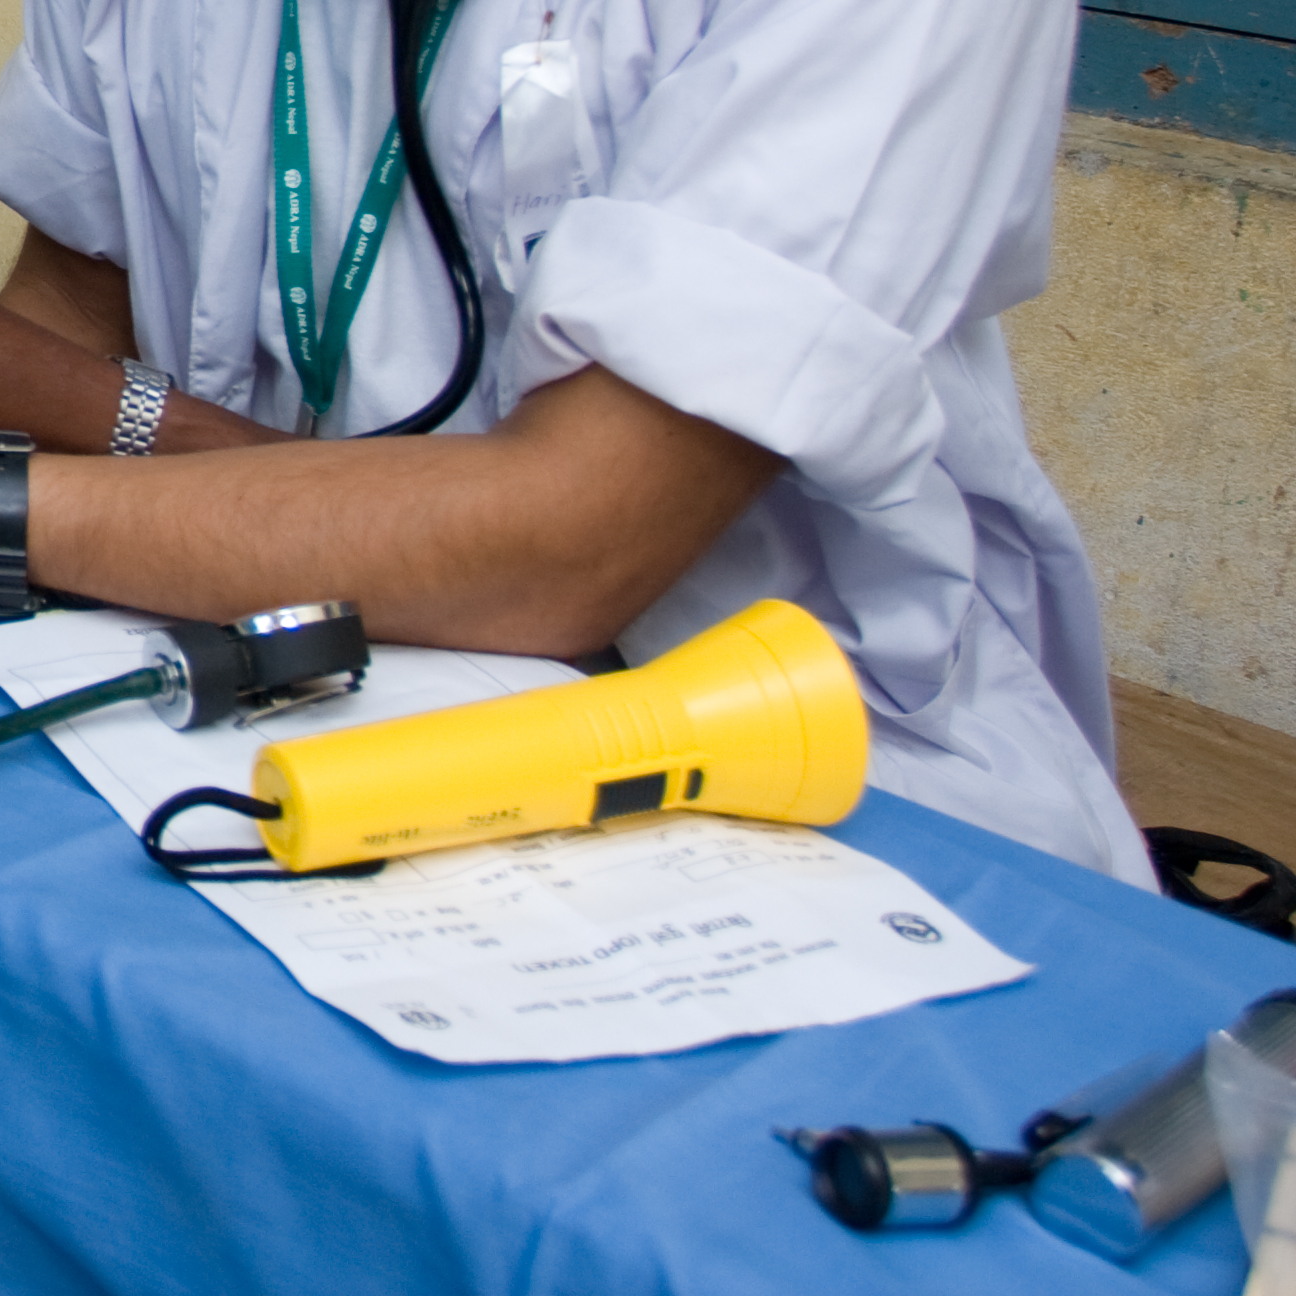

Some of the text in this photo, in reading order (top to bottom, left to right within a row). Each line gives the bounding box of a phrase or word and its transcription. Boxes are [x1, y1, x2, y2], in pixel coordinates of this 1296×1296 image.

[285, 73, 298, 135] ADRA Nepal
[378, 131, 401, 185] DRA Nepal
[287, 191, 302, 254] ADRA Nepal
[343, 234, 370, 291] ADRA Nepal
[296, 306, 312, 362] ADRA Nepal
[510, 954, 593, 975] TICKET)
[592, 934, 643, 960] (OPD
